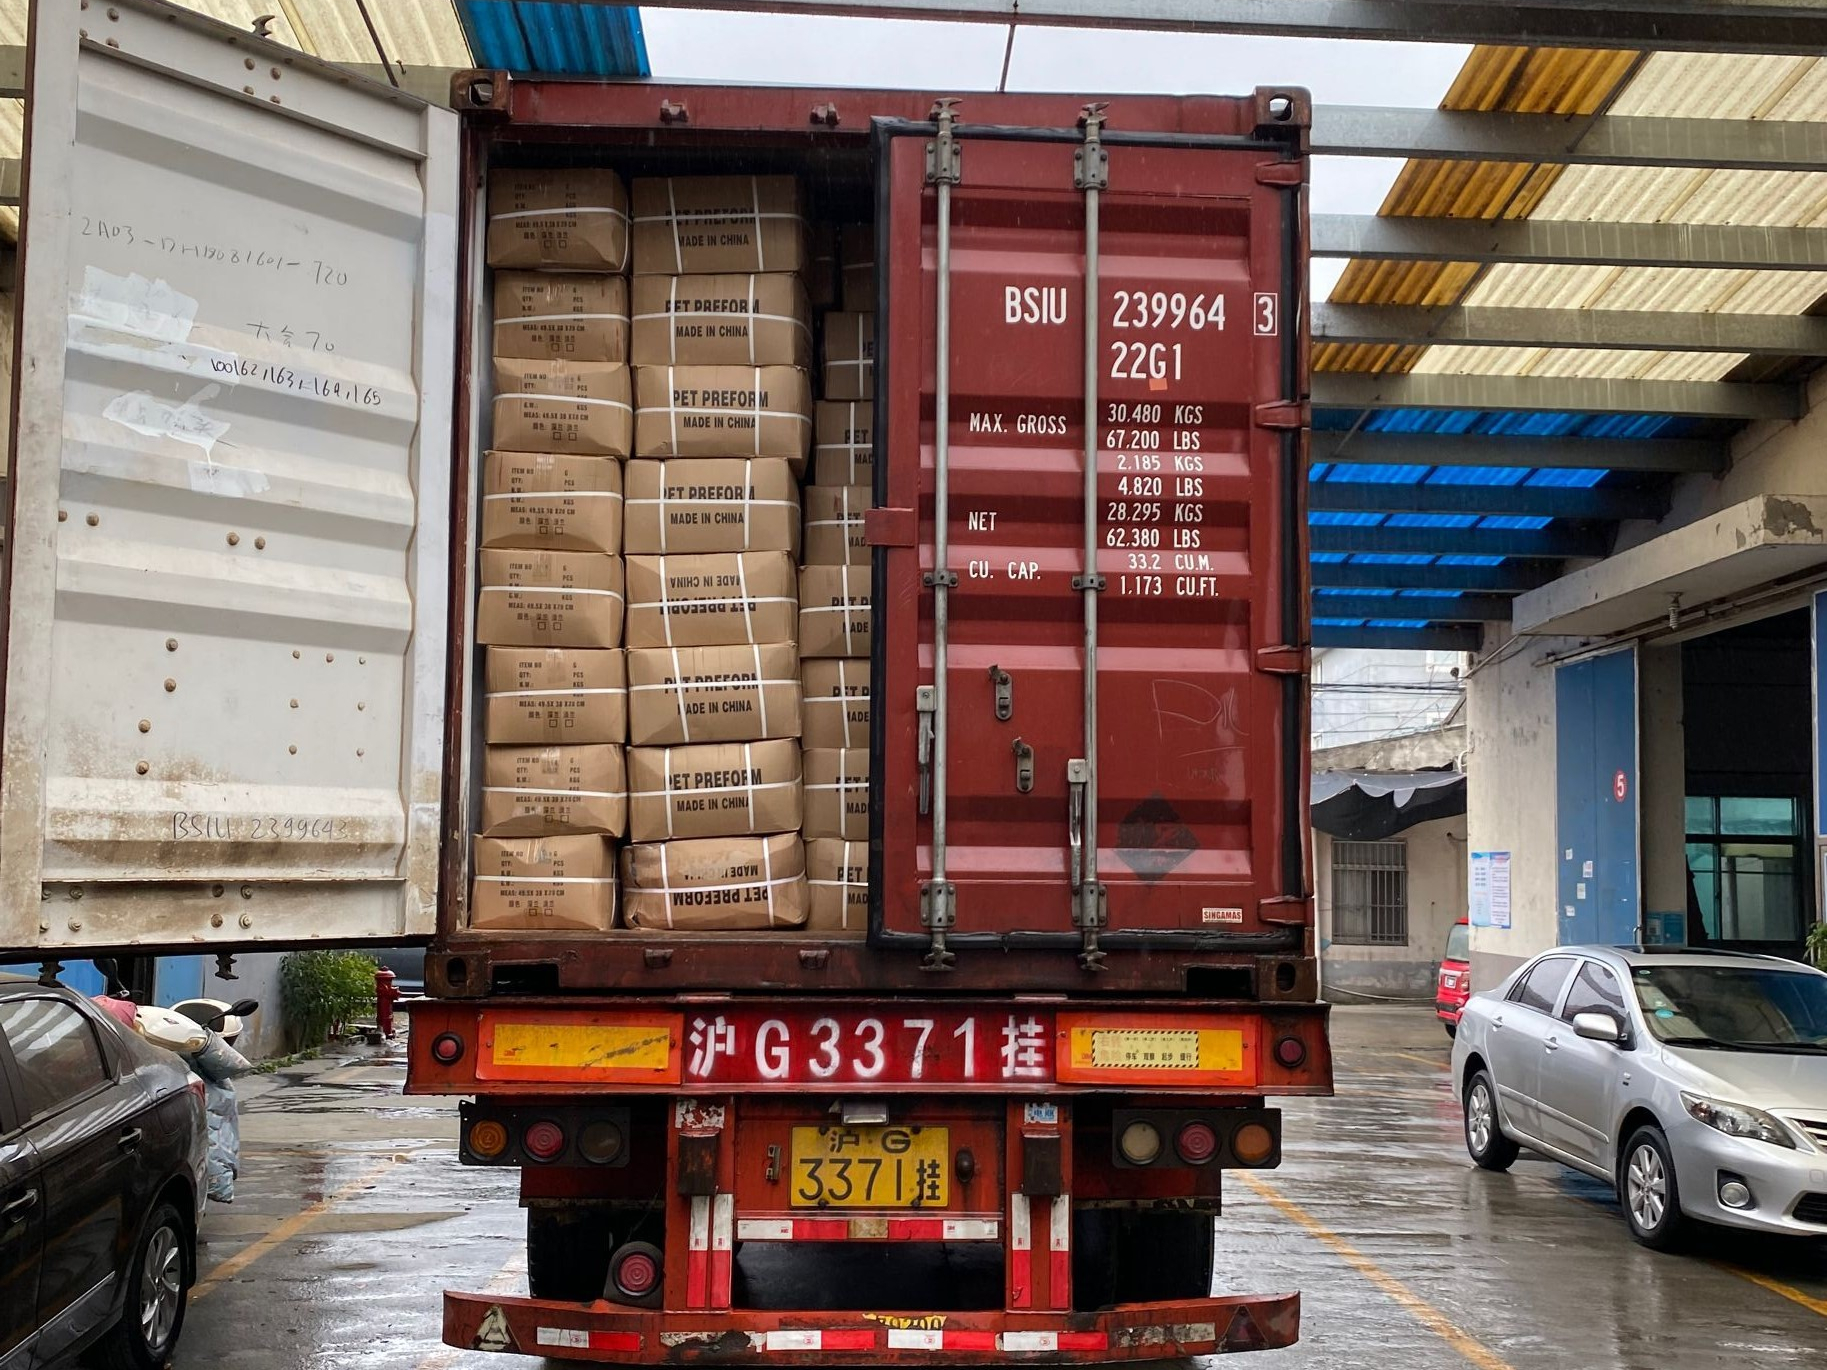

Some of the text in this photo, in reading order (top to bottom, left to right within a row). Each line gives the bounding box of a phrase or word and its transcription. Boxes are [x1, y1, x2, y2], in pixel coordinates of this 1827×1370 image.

[708, 235, 716, 246] IN
[720, 234, 750, 246] CHINA
[1005, 286, 1274, 332] BSIU 239964 3
[676, 325, 748, 338] MADE IN CHINA
[1110, 341, 1182, 380] 22G1
[674, 390, 768, 408] PET PREFORM
[683, 416, 756, 429] MADE IN CHINA
[970, 412, 1066, 434] MAX. GROSS
[1108, 404, 1204, 424] 30,480 KGS
[1106, 430, 1200, 450] 67,200 LBS
[1174, 455, 1204, 472] KGS
[1118, 476, 1203, 496] 4,820 LBS
[670, 512, 744, 524] MADE IN CHINA
[1108, 502, 1204, 522] 28,295 KGS
[968, 512, 997, 531] NET
[1106, 528, 1200, 548] 62,380 LBS
[969, 560, 1041, 580] CU. CAP.
[1128, 554, 1214, 571] 33.2 CU.M.
[670, 576, 700, 588] CHINA
[704, 576, 713, 588] IN
[1120, 576, 1218, 596] 1,173 CU.FT.
[708, 702, 718, 714] IN
[722, 700, 752, 713] CHINA
[1616, 774, 1625, 798] 5
[676, 799, 705, 812] MADE
[708, 798, 718, 810] IN
[730, 864, 758, 878] MADE
[673, 889, 740, 906] PREFORM
[1204, 911, 1241, 920] SINGAMAS
[689, 1015, 1048, 1078] 沪G3371挂
[798, 1158, 941, 1200] 3371挂
